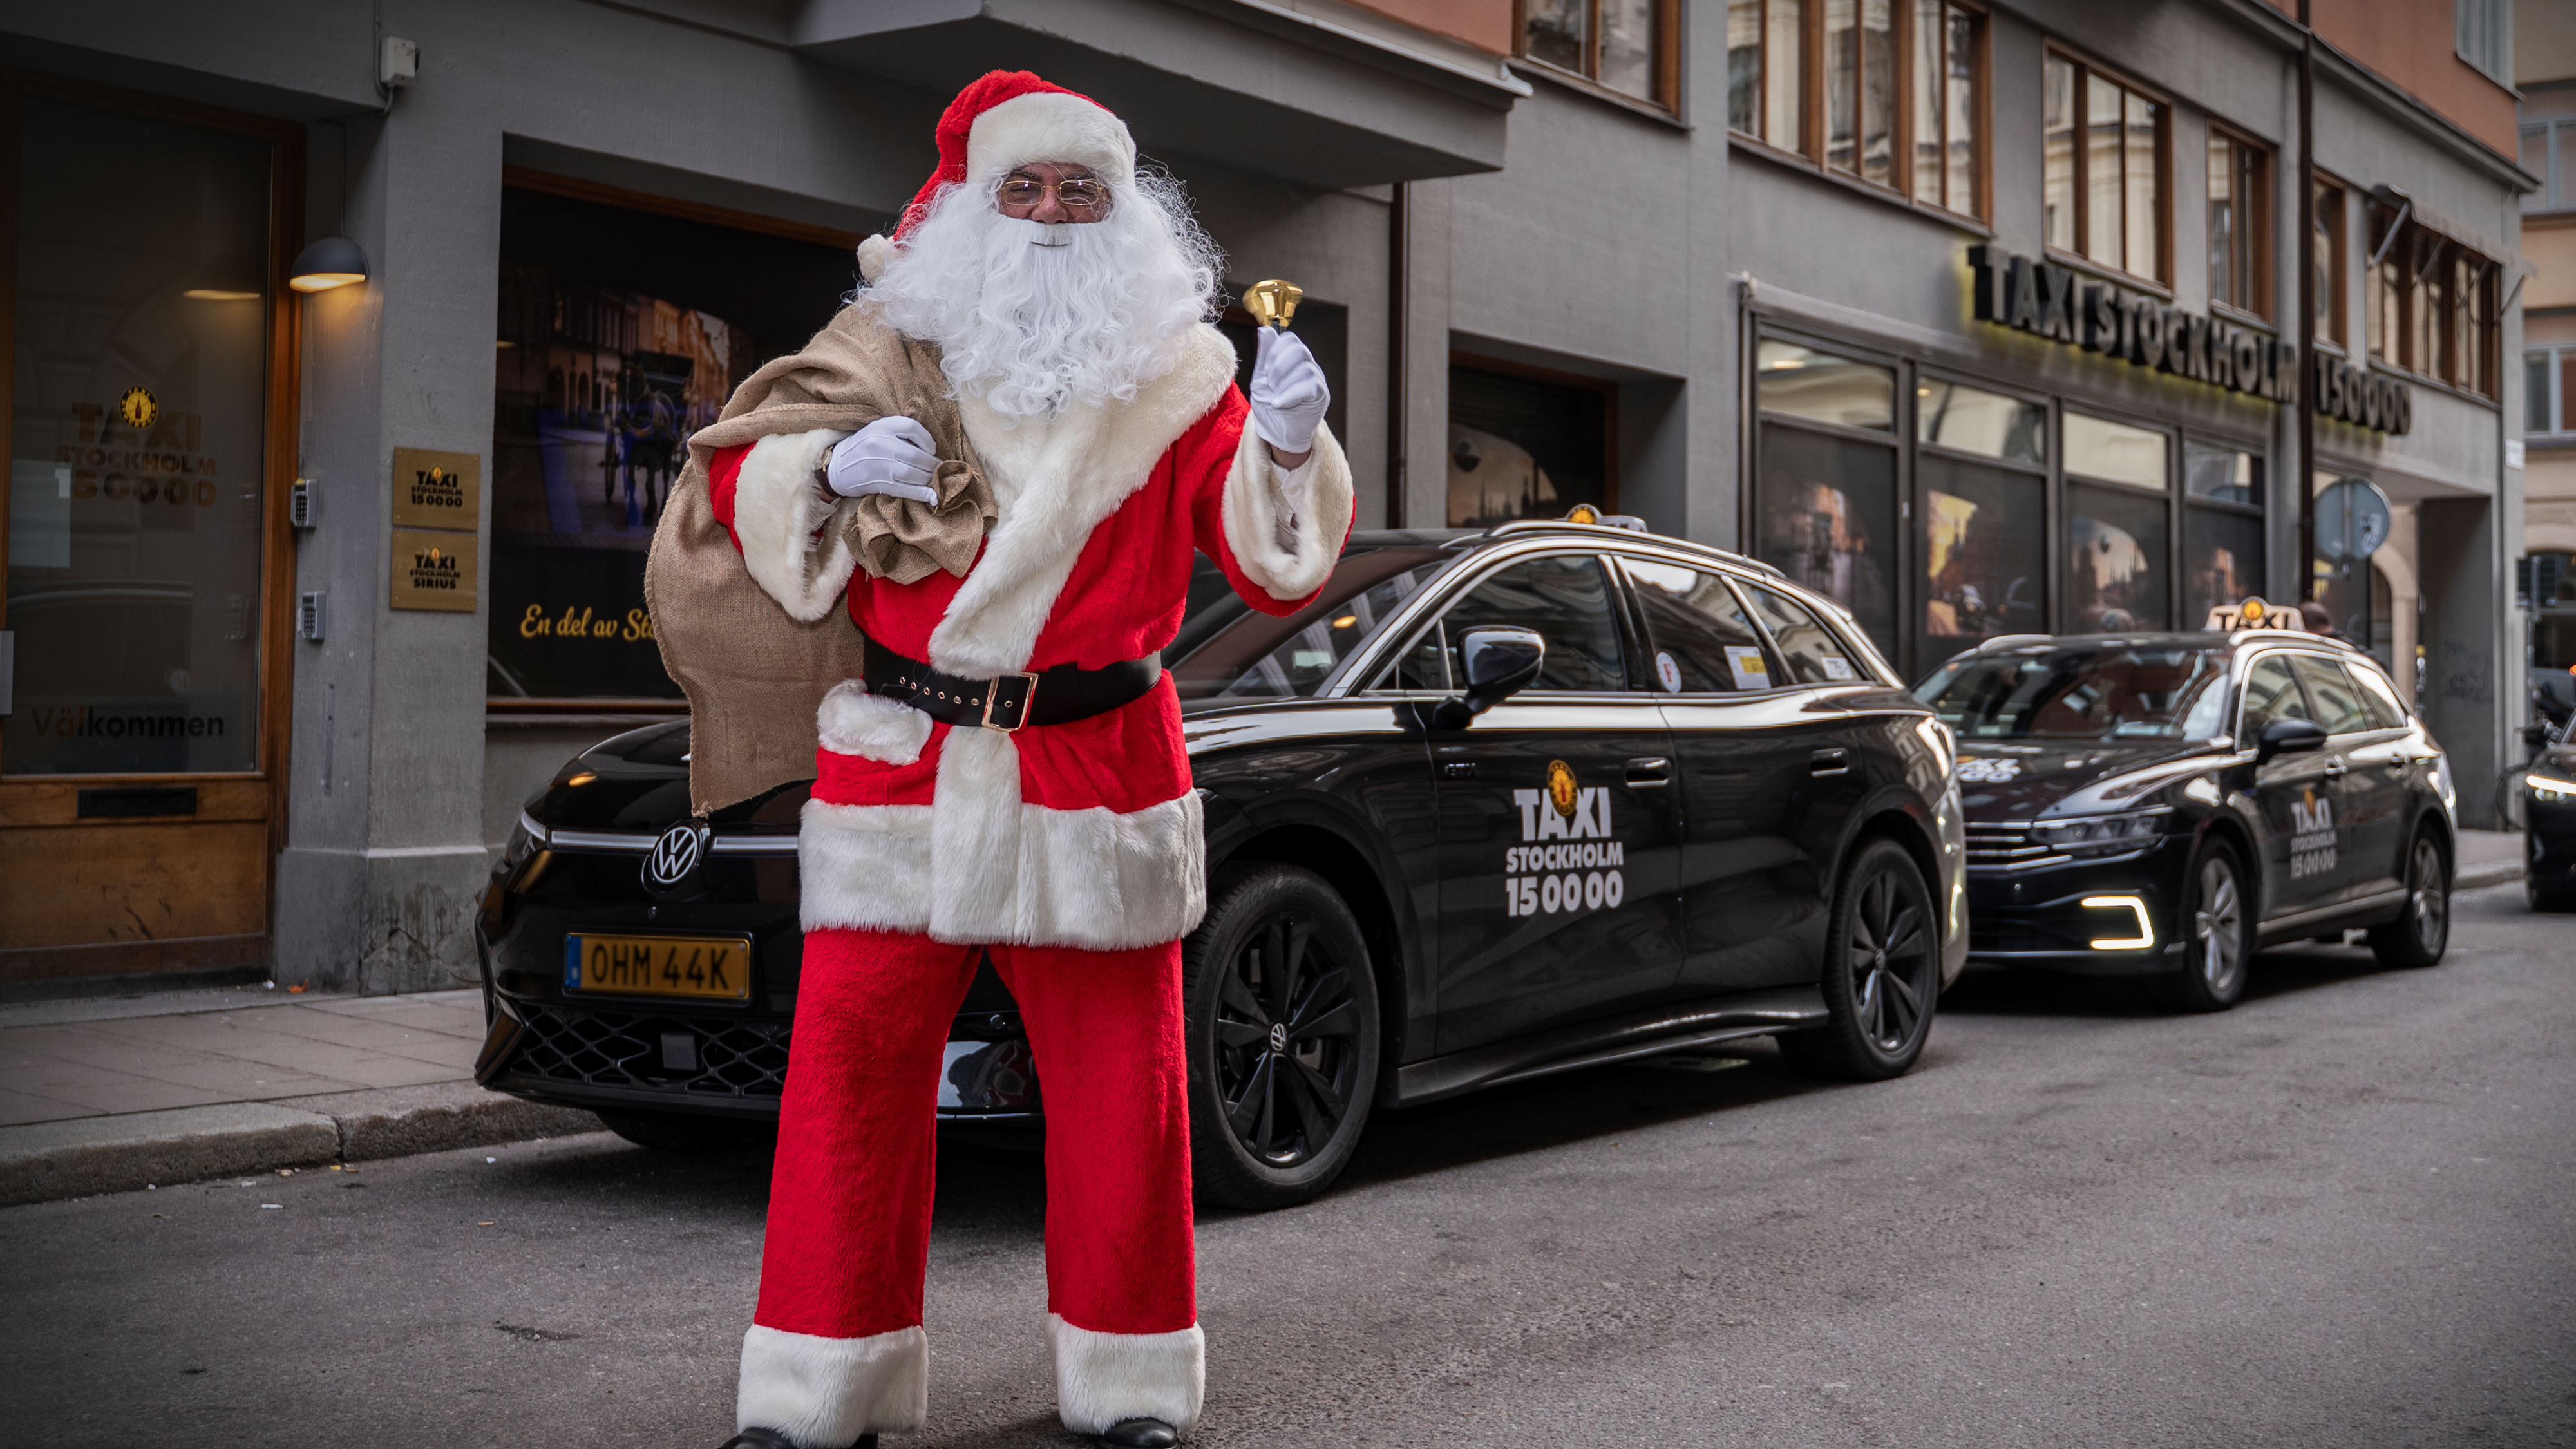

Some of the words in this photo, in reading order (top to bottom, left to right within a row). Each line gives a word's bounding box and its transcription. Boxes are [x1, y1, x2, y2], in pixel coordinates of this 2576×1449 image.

[1969, 244, 2085, 346] TAXI
[2087, 282, 2298, 404] STOCKHOLM
[71, 401, 202, 451] TAXI
[55, 446, 218, 476] STOCKHOLM
[411, 486, 463, 496] STOCKHOLM
[416, 470, 458, 488] TAXI
[409, 569, 460, 578] STOCKHOLM
[414, 554, 456, 570] TAXI
[413, 578, 457, 589] SIRIUS
[520, 603, 551, 638] En
[556, 605, 592, 637] del
[592, 620, 618, 637] av
[2215, 612, 2289, 630] TAXI
[31, 705, 224, 737] Välkommen
[1513, 786, 1611, 841] TAXI
[2290, 798, 2333, 834] TAXI
[1506, 841, 1624, 873] STOCKHOLM
[591, 943, 651, 987] OHM
[662, 946, 730, 991] 44K
